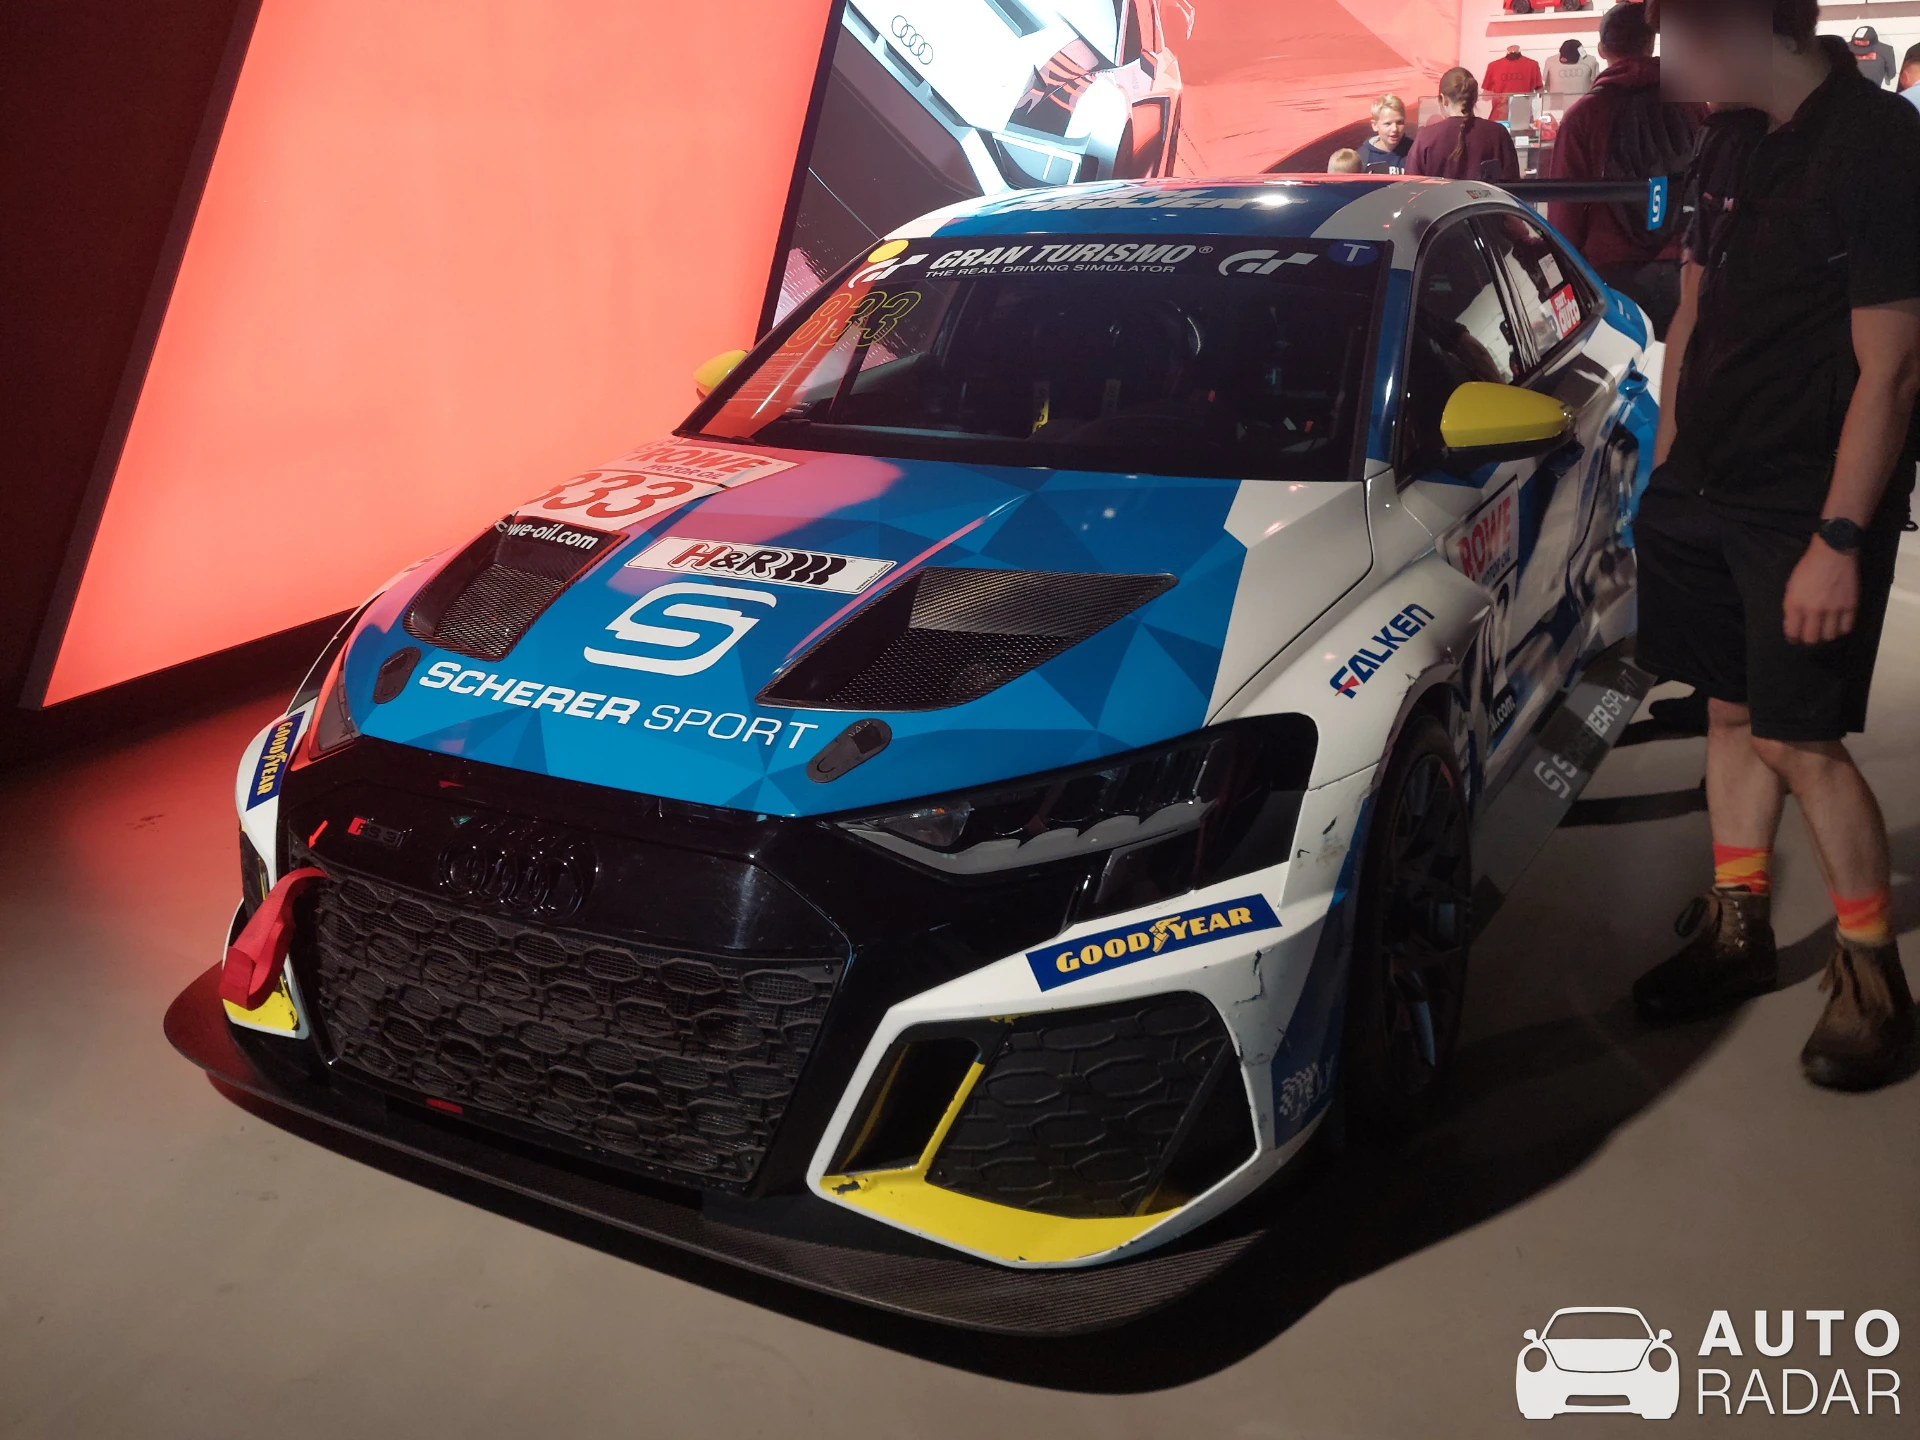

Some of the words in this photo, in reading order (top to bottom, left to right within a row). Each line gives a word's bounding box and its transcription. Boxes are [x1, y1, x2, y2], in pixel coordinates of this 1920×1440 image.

[925, 269, 955, 278] THE
[957, 267, 997, 276] REAL
[1001, 264, 1068, 273] DRIVING
[1072, 264, 1176, 274] SIMULATOR
[929, 245, 1034, 270] GRAN
[1343, 243, 1371, 262] T
[785, 291, 922, 348] 833
[626, 448, 773, 475] ROWE
[642, 463, 698, 478] MOTOR
[697, 468, 724, 480] OIL
[667, 543, 784, 577] H&R
[1447, 496, 1511, 582] ROWE
[1330, 603, 1435, 699] FALKEN
[419, 660, 641, 725] SCHERER
[644, 704, 819, 750] SPORT
[256, 721, 293, 796] GOODYEAR
[1055, 907, 1253, 974] GOODYEAR
